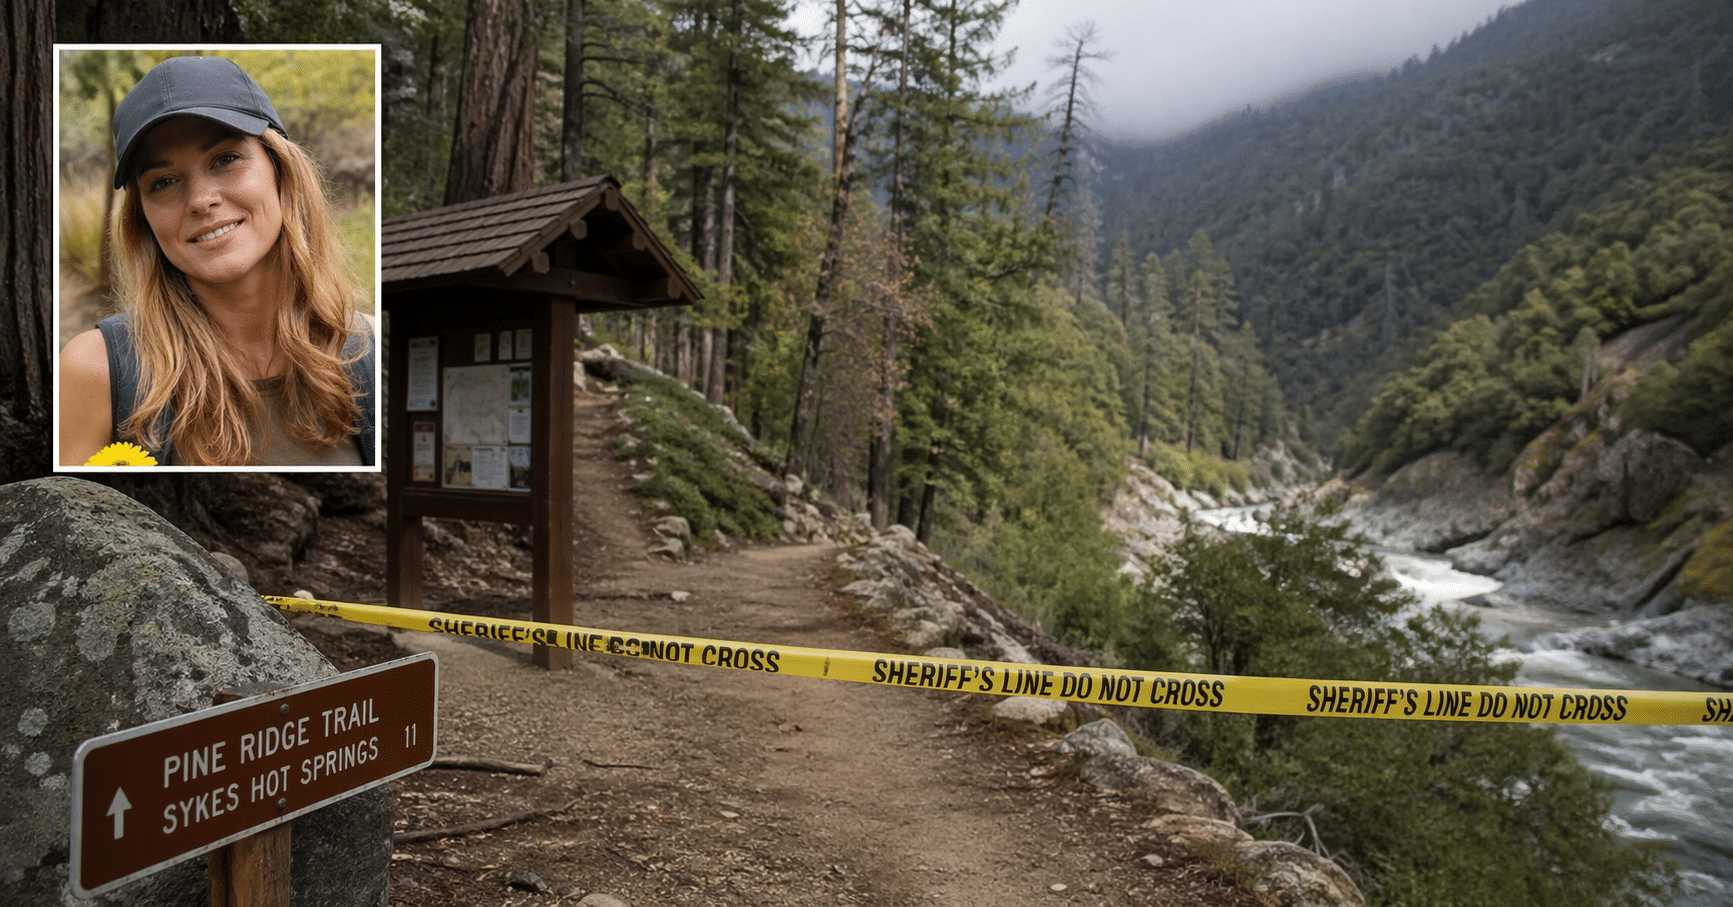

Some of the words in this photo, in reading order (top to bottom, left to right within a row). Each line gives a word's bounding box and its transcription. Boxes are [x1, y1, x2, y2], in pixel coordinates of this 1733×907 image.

[649, 639, 695, 663] NOT
[701, 644, 781, 673] CROSS
[872, 658, 995, 692] SHERIFF'S
[1001, 669, 1053, 696] LINE
[1060, 673, 1093, 699] DO
[1098, 674, 1145, 703] NOT
[1151, 678, 1225, 708] CROSS
[1307, 684, 1419, 715] SHERIFF'S
[1423, 690, 1473, 718] LINE
[1477, 692, 1508, 719] DO
[1511, 693, 1555, 720] NOT
[1559, 695, 1629, 721] CROSS
[163, 741, 227, 789] PINE
[240, 715, 311, 764] RIDGE
[321, 698, 380, 738] TRAIL
[162, 783, 240, 835] SYKES
[250, 765, 291, 803] HOT
[300, 736, 380, 785] SPRINGS
[404, 723, 417, 749] 11
